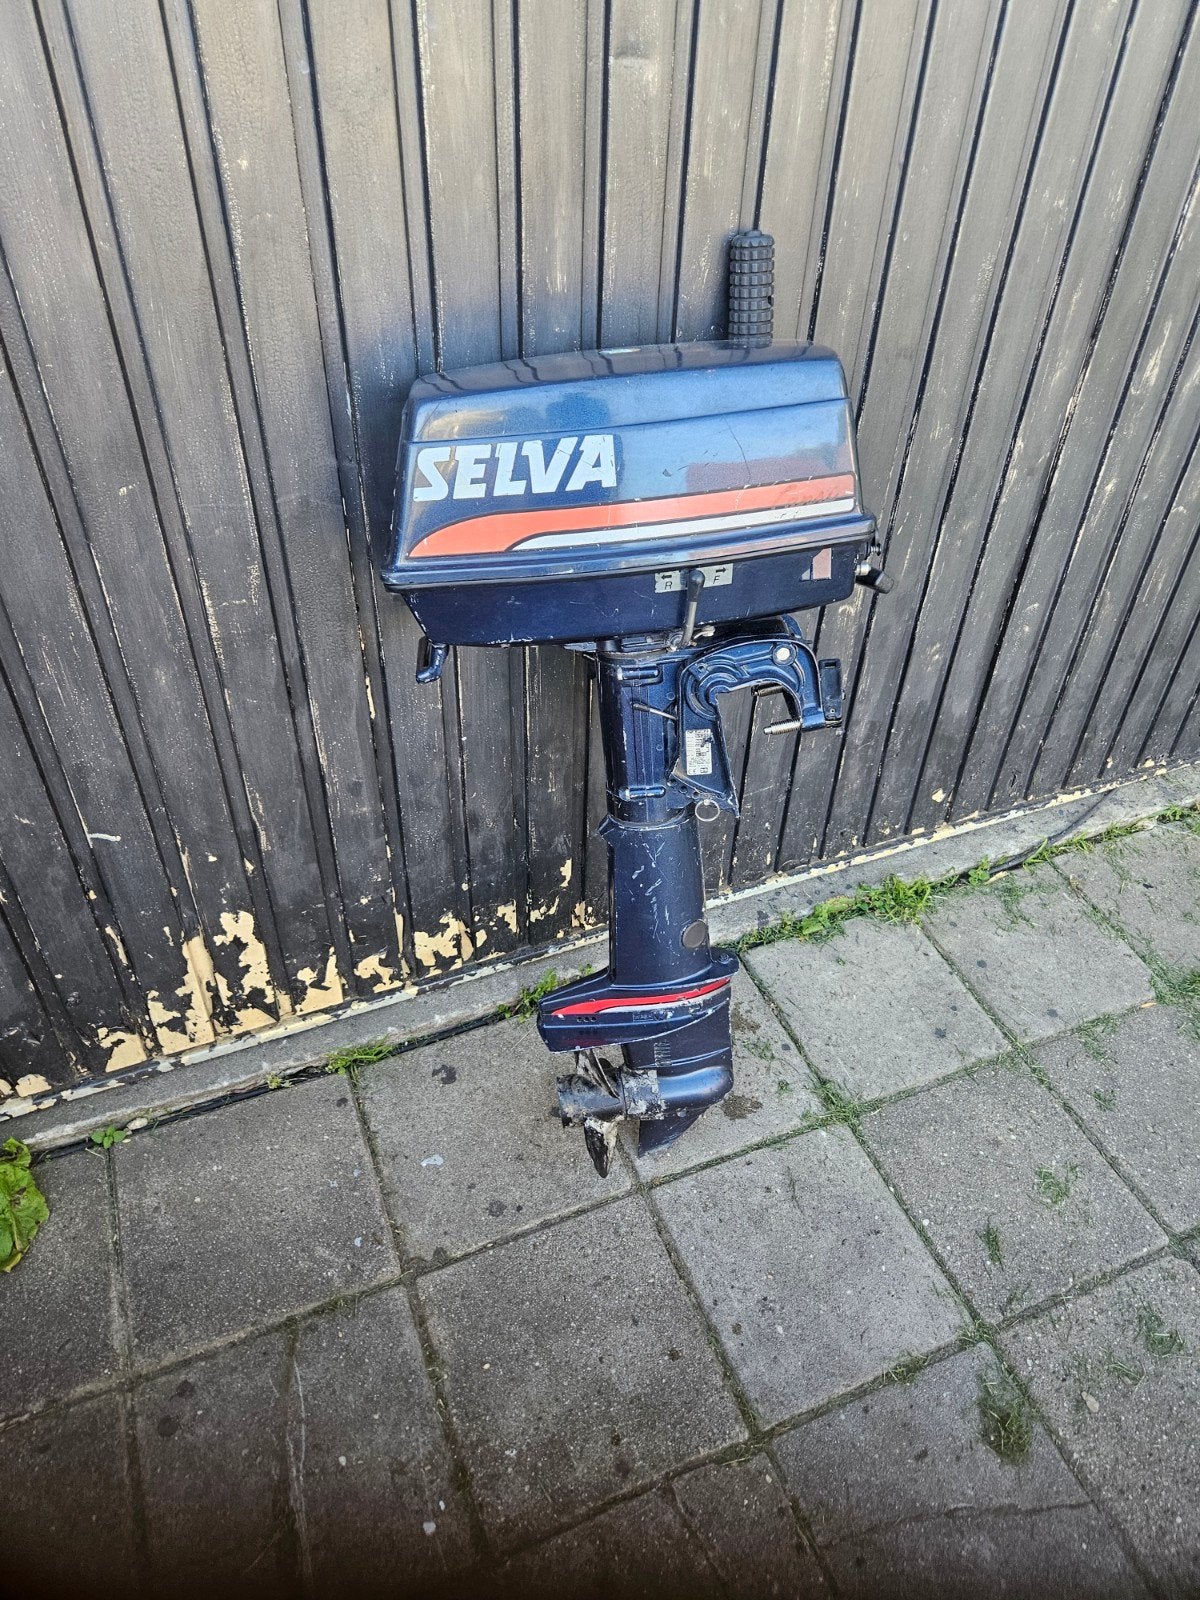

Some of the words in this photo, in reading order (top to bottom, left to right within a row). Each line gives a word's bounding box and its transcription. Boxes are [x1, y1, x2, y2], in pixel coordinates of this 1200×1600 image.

[413, 434, 617, 502] SELVA
[712, 575, 721, 584] F
[664, 581, 673, 590] R
